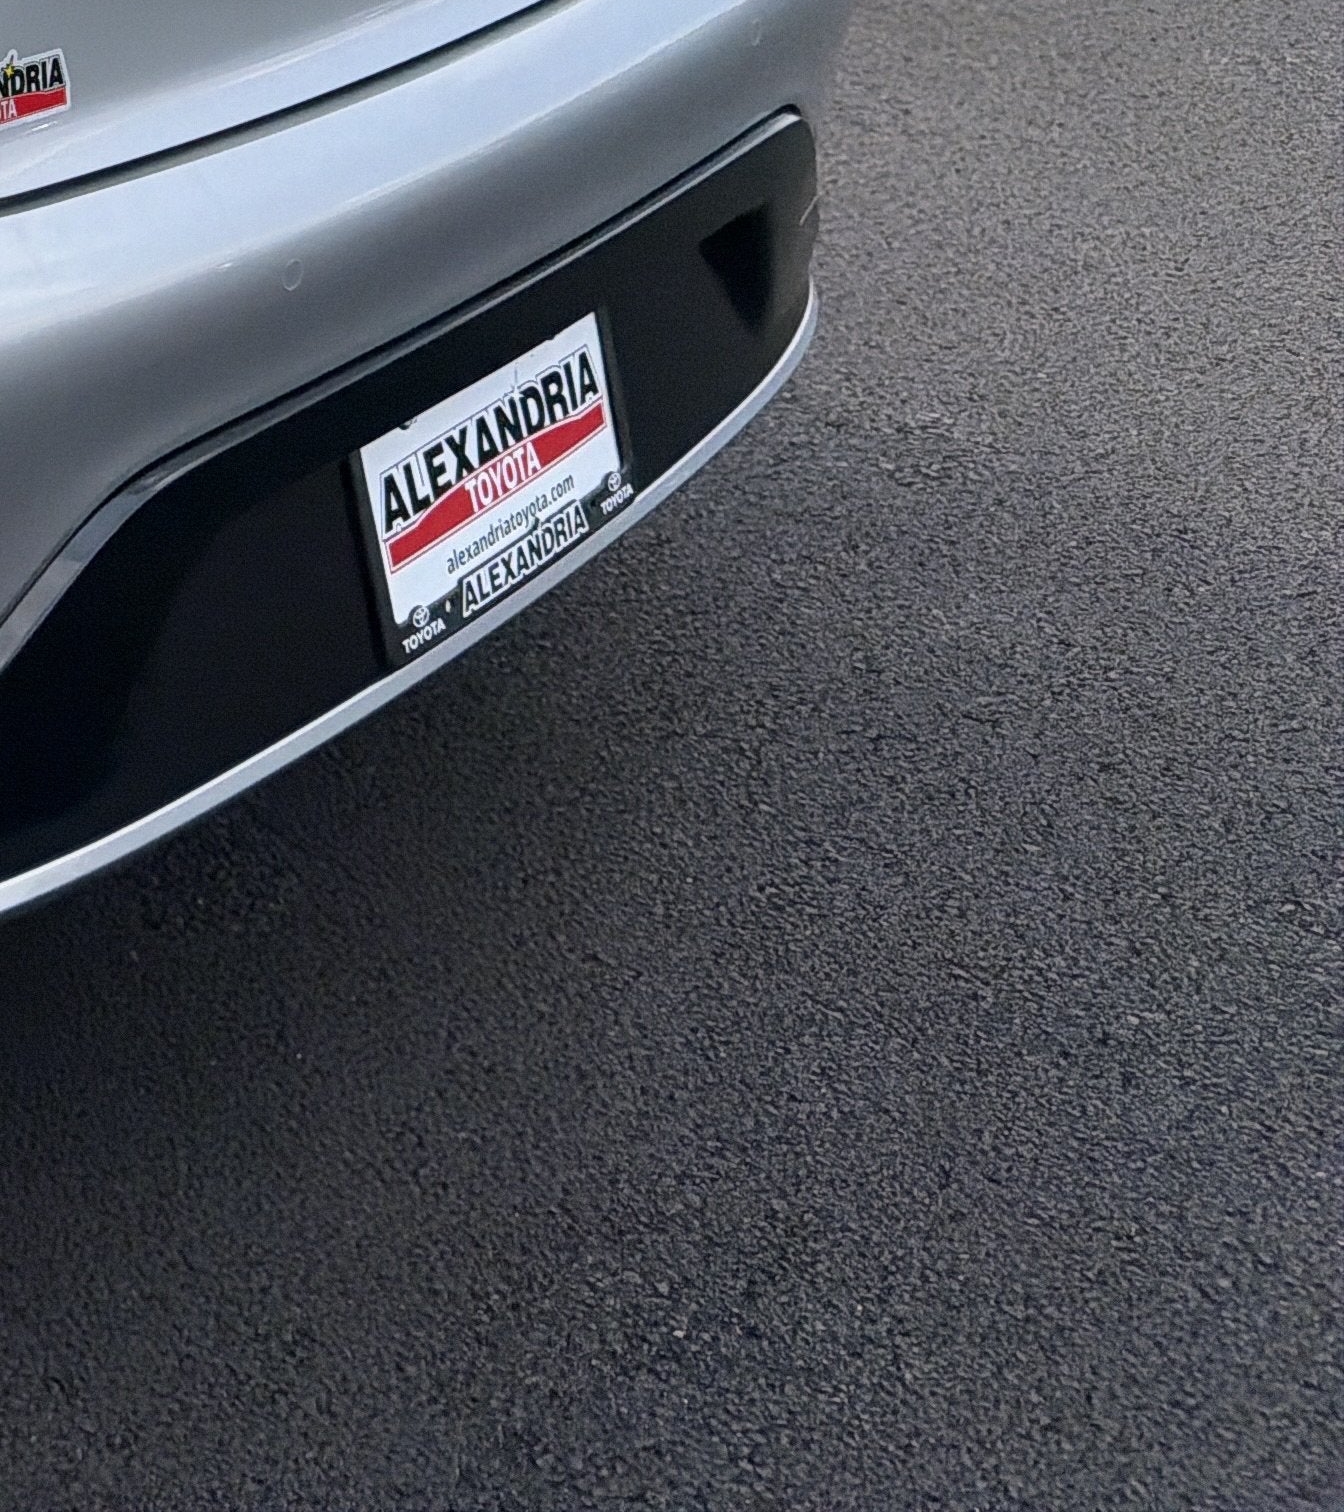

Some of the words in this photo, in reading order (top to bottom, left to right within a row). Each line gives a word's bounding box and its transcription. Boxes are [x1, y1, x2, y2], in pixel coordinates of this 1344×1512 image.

[383, 351, 600, 533] ALEXANDRIA
[464, 441, 543, 514] TOYOTA
[446, 474, 575, 575] alexandriatoyota.com
[600, 484, 634, 515] TOYOTA
[463, 501, 588, 615] ALEXANDRIA
[402, 618, 447, 654] TOYOTA
